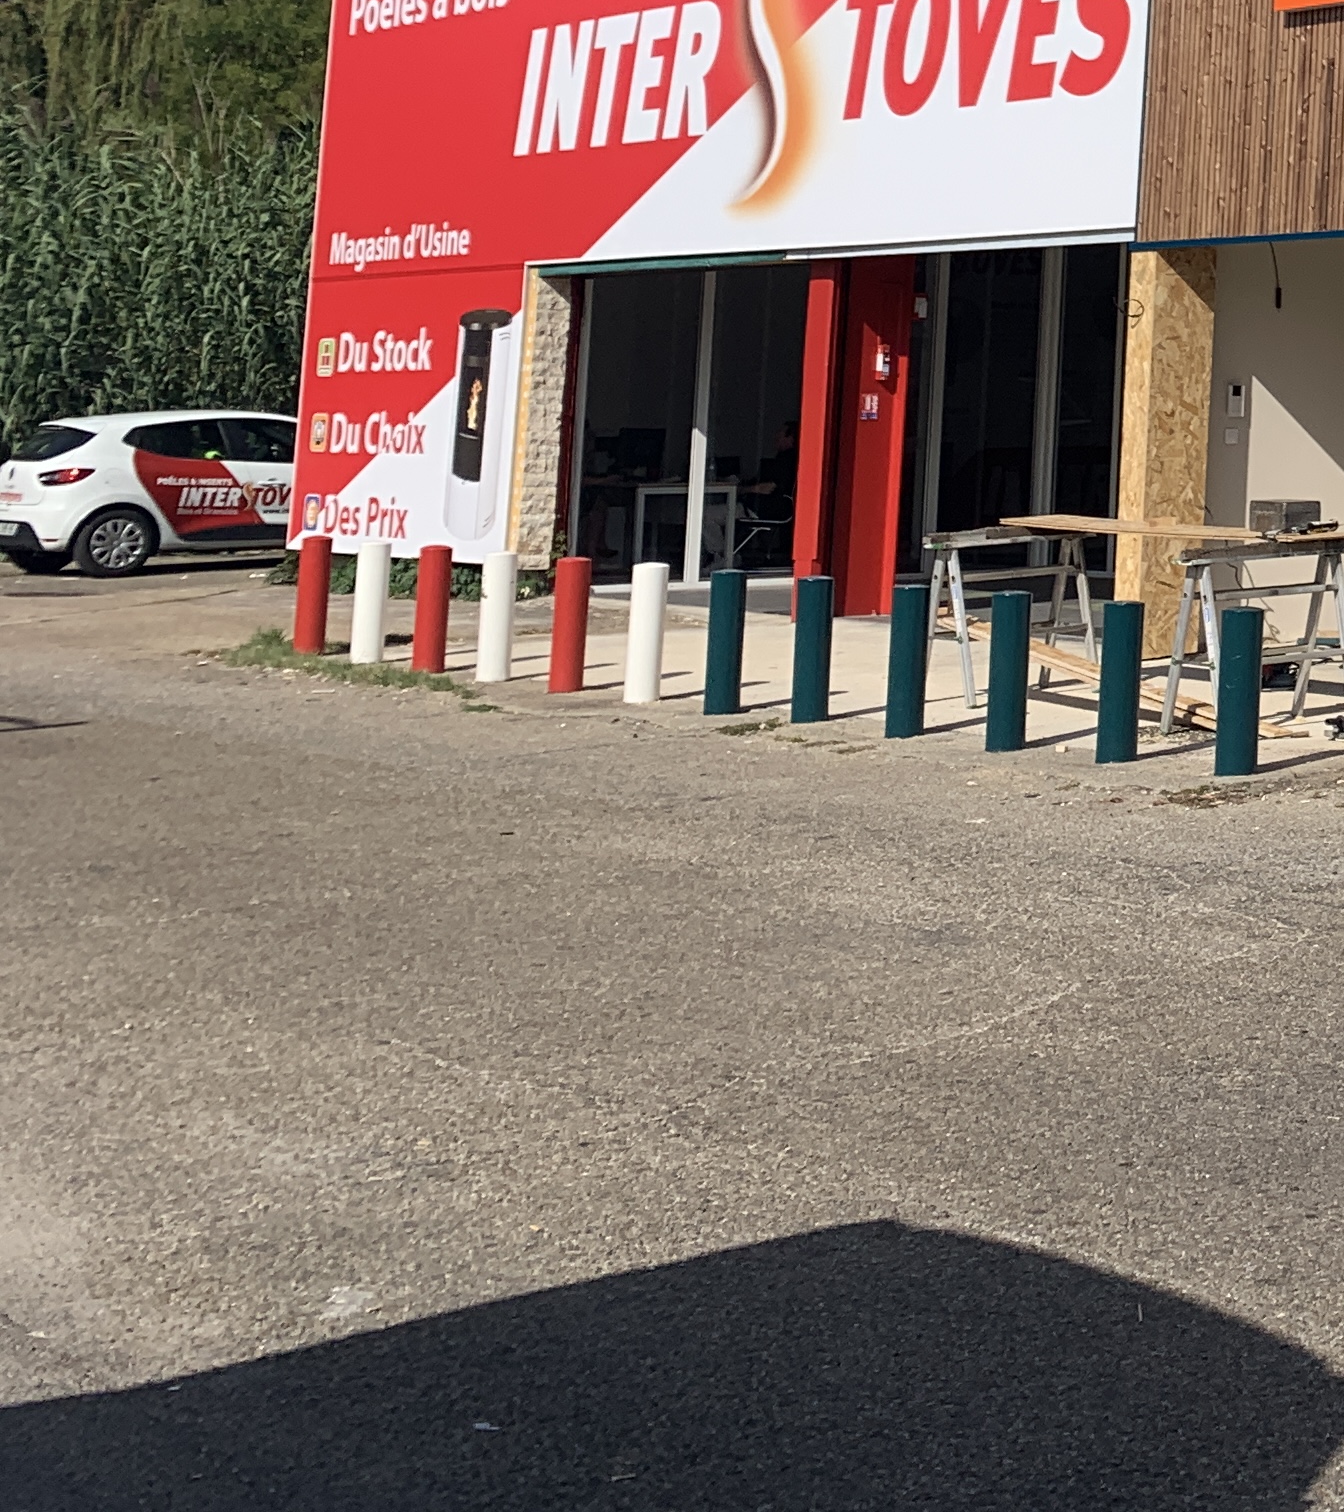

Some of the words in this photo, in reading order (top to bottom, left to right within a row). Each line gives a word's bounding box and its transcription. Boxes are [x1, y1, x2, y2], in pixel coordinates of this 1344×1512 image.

[513, 0, 722, 157] INTER
[329, 226, 401, 273] Magasin
[337, 331, 369, 373] Du
[370, 326, 433, 372] Stock
[329, 412, 361, 455] Du
[363, 410, 427, 455] Choix
[179, 486, 241, 507] INTER
[324, 494, 361, 535] Des
[366, 496, 409, 538] Prix
